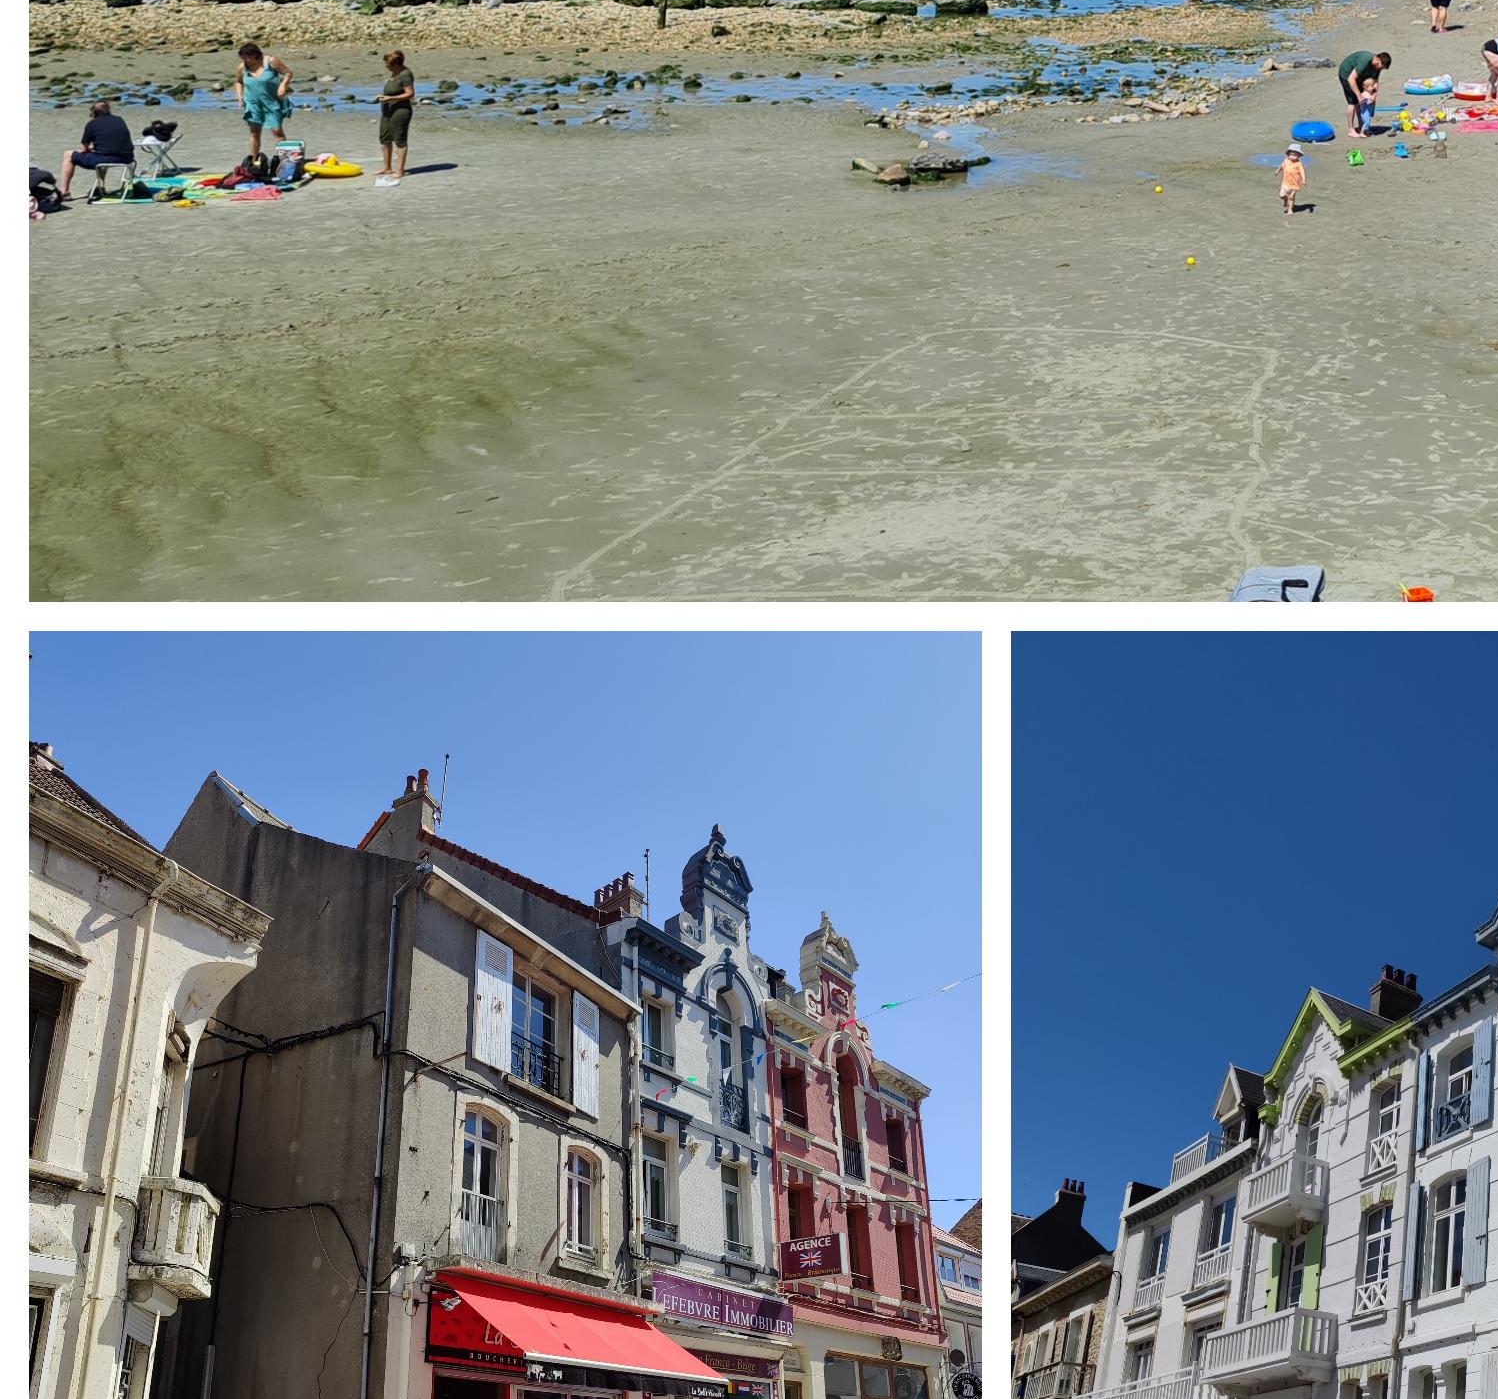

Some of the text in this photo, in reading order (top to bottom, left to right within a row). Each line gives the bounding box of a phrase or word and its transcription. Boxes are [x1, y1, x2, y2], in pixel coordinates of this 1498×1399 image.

[789, 1237, 832, 1252] AGENCE
[698, 1288, 755, 1309] CABINET
[652, 1286, 794, 1336] LEFEBVRE IMMOBILIER
[485, 1321, 504, 1346] La
